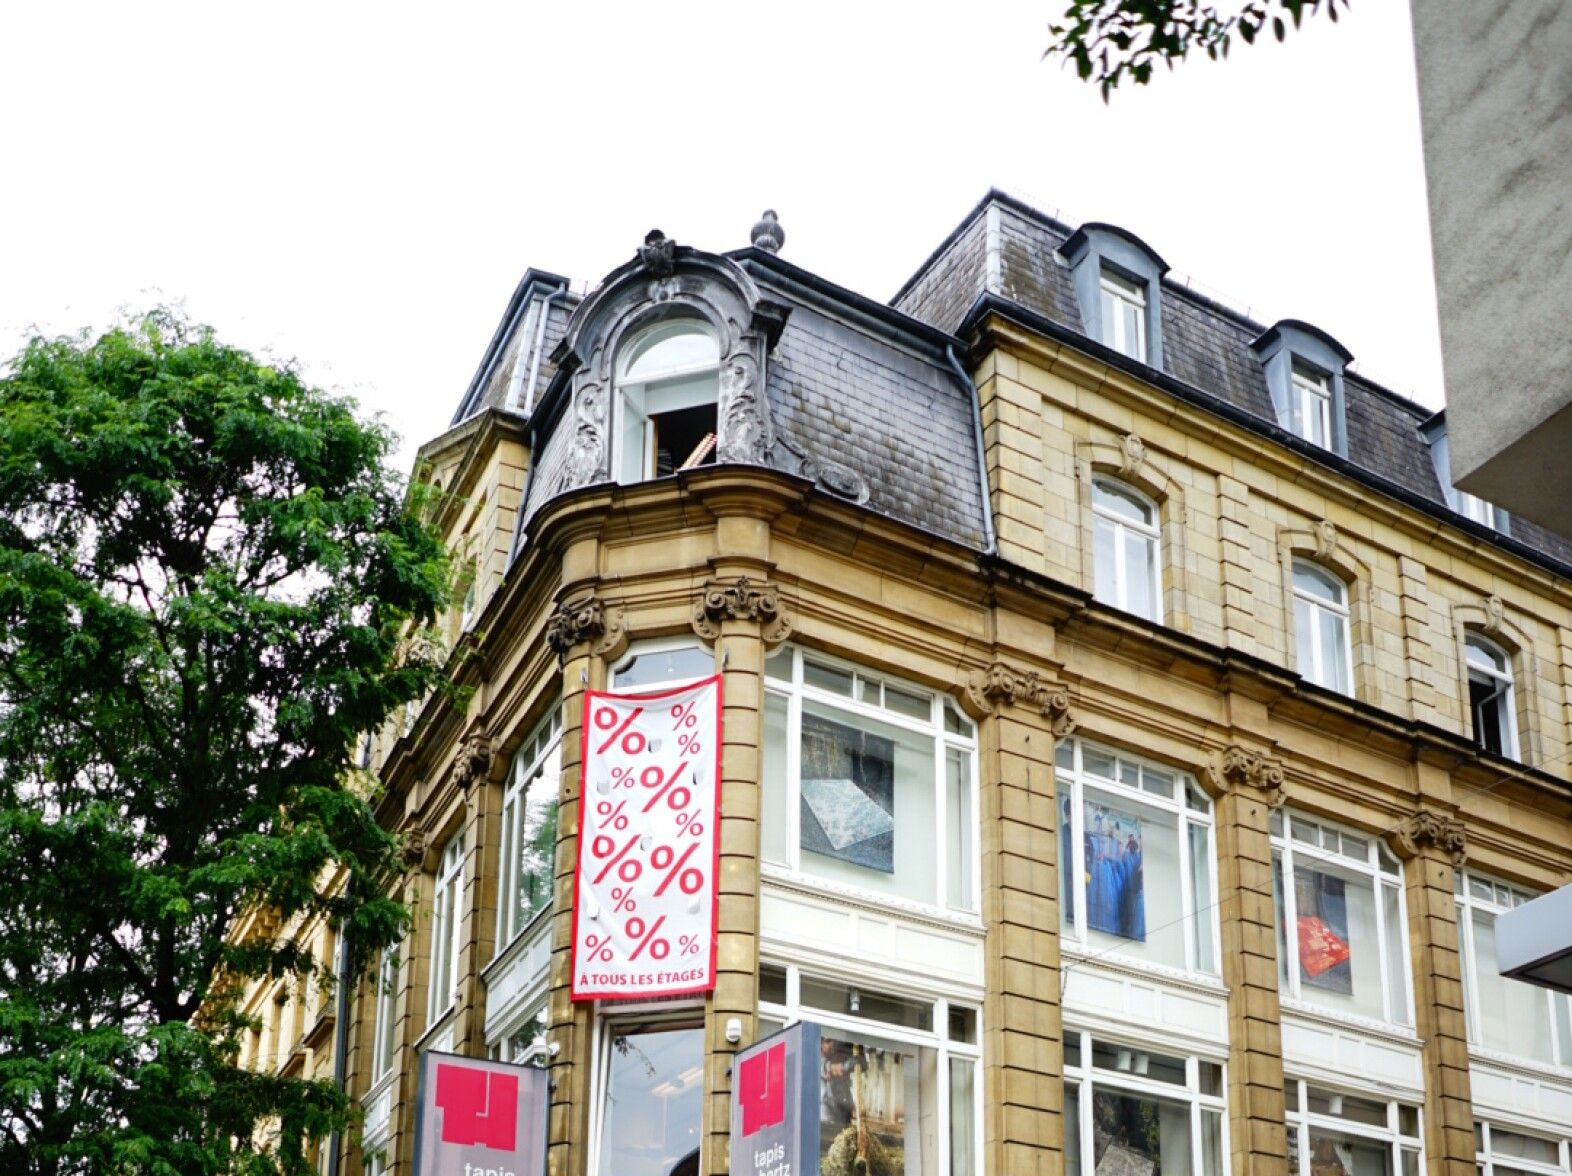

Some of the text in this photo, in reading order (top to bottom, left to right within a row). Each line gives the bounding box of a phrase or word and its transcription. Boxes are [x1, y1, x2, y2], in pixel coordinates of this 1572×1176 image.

[591, 974, 627, 985] TOUS
[630, 974, 653, 985] LES
[754, 1144, 785, 1169] tapis
